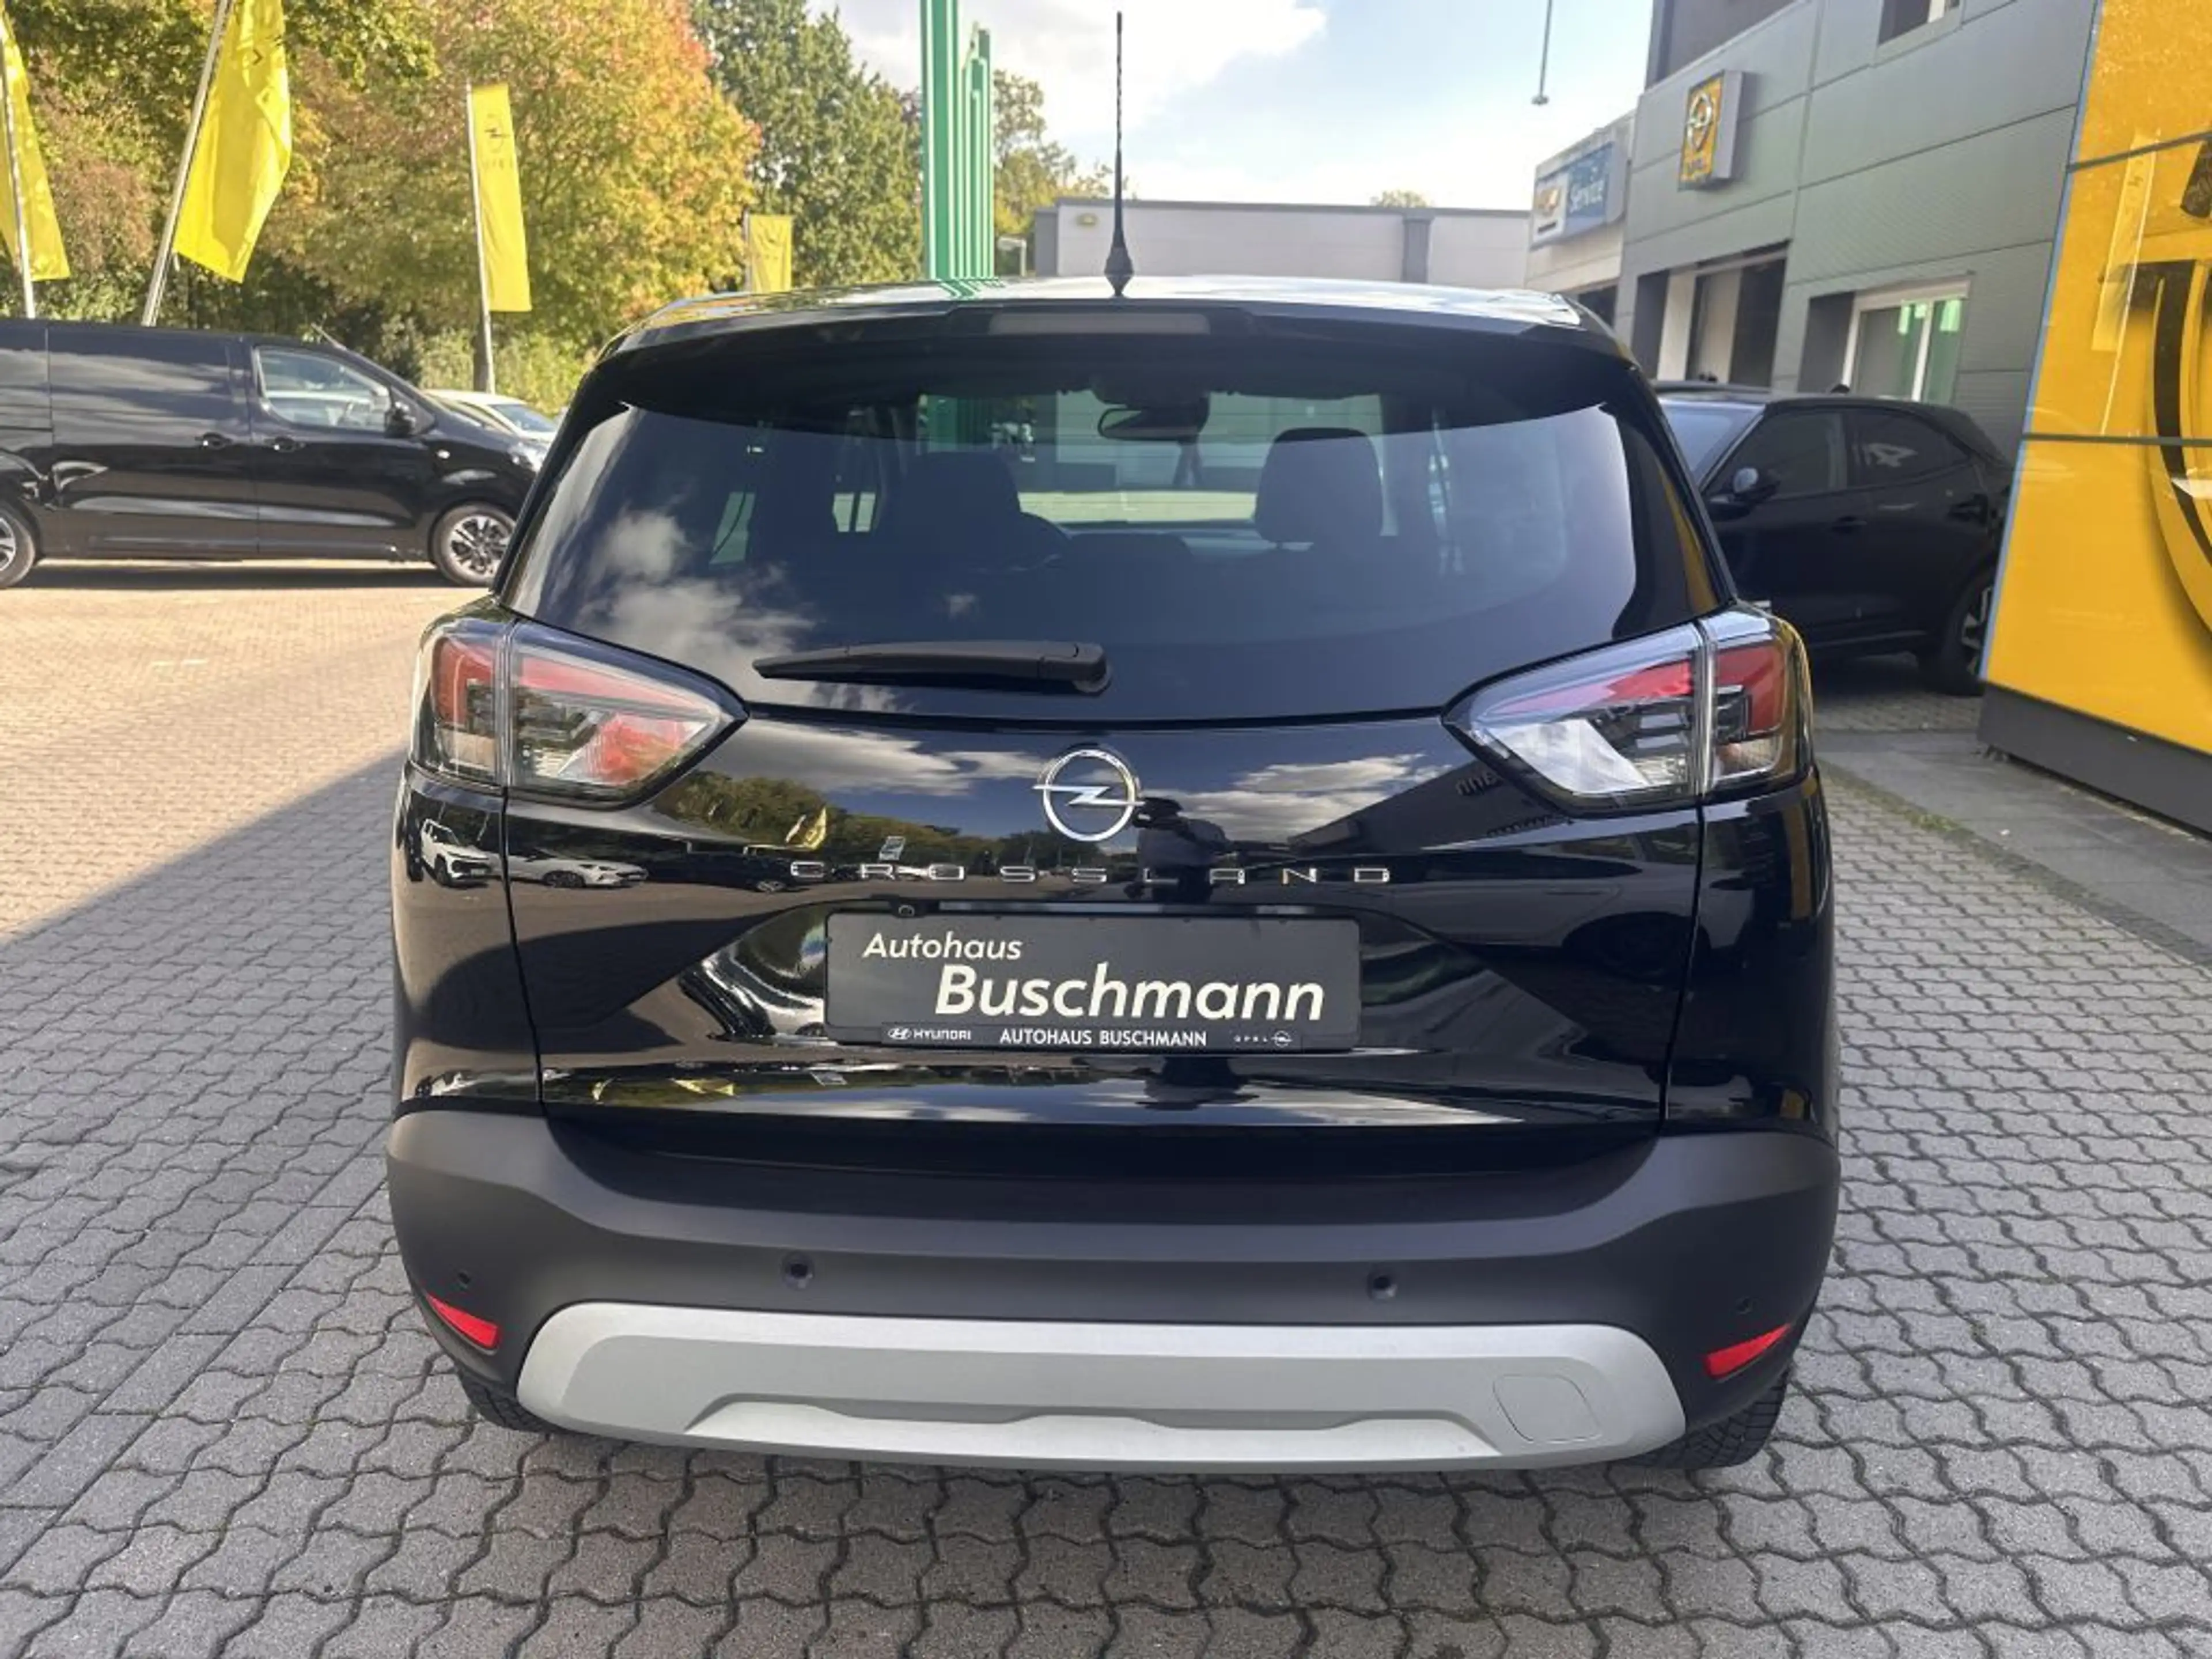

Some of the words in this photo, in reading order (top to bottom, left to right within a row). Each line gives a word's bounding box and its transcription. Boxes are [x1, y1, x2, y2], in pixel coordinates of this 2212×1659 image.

[790, 861, 1390, 885] CROSSLAND
[862, 931, 1022, 960] Autohaus
[935, 961, 1324, 1020] Buschmann
[914, 1029, 971, 1041] HYUNDAI
[1000, 1028, 1092, 1045] AUTOHAUS
[1099, 1030, 1207, 1047] BUSCHMANN
